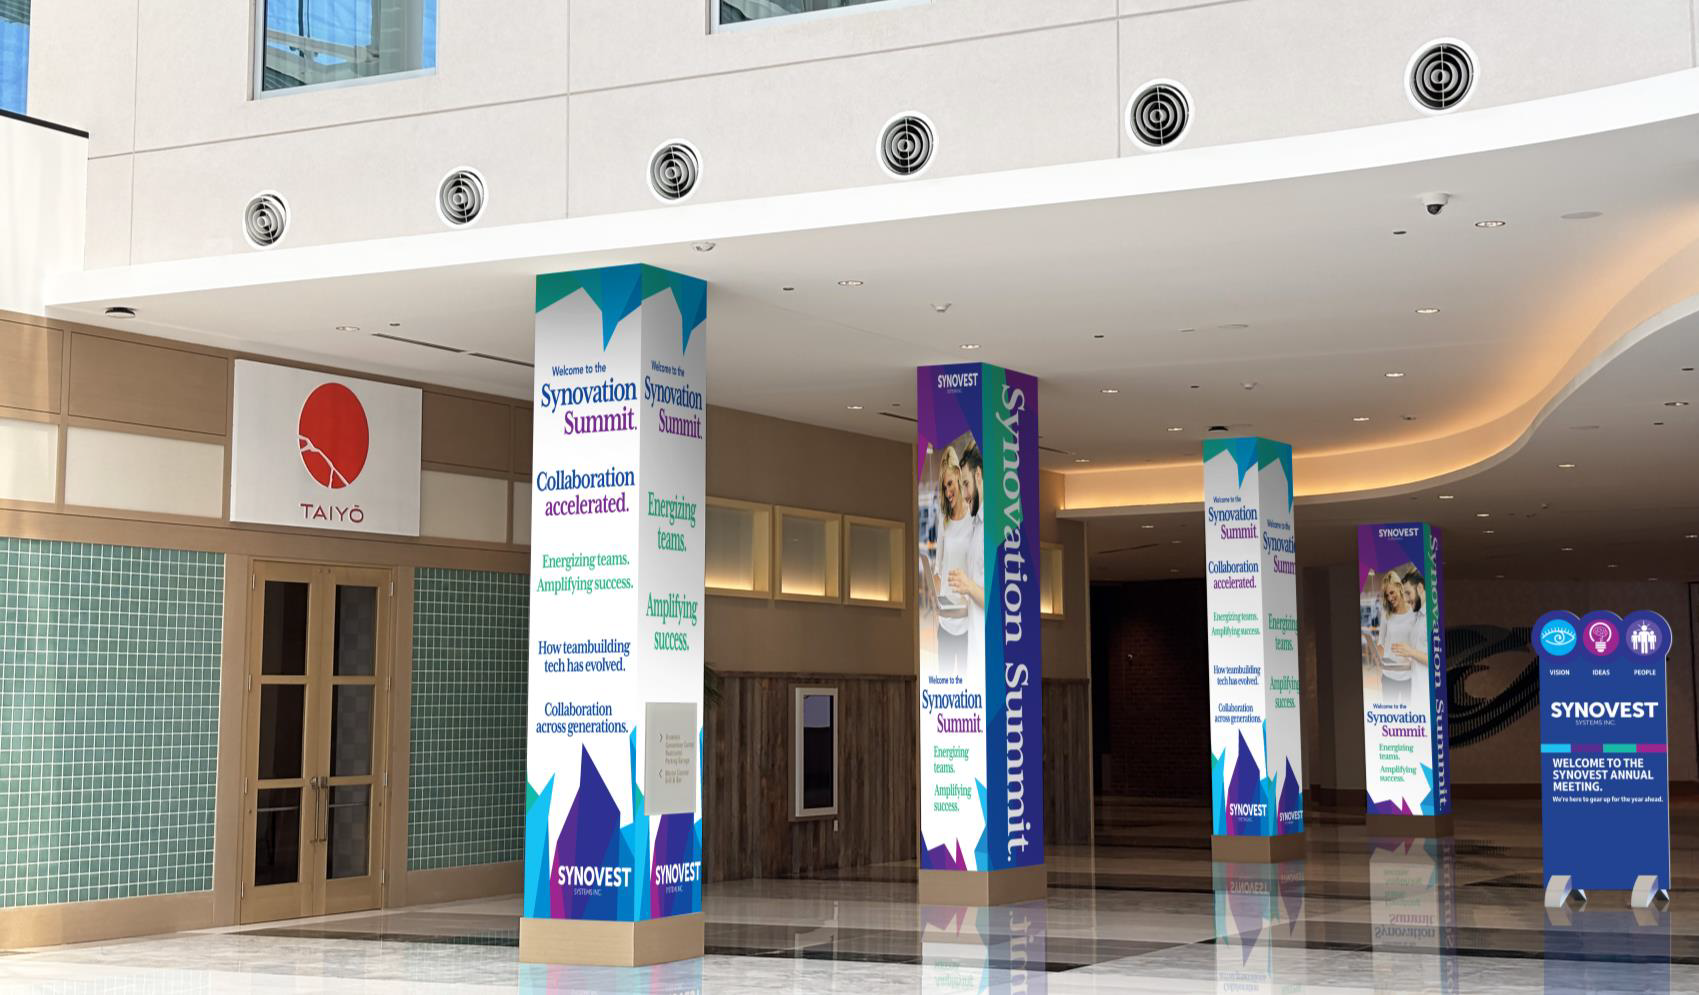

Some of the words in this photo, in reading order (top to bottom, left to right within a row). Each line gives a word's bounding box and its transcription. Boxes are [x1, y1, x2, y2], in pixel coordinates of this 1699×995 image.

[552, 365, 583, 377] Welcome
[585, 365, 593, 374] to
[594, 362, 606, 373] the
[651, 360, 671, 374] Welcome
[672, 365, 676, 375] to
[938, 373, 978, 388] SYNOVEST
[541, 377, 637, 413] Synovation
[644, 376, 702, 410] Synovation
[564, 406, 638, 435] Summit.
[658, 408, 703, 440] Summit.
[536, 466, 635, 492] Collaboration
[545, 492, 629, 516] accelerated.
[648, 491, 697, 528] Energizing
[996, 384, 1028, 646] Synovation
[1208, 506, 1258, 526] Synovation
[657, 527, 687, 552] teams.
[1221, 523, 1258, 540] Summit.
[1378, 528, 1419, 538] SYNOVEST
[542, 553, 596, 571] Energizing
[597, 553, 630, 566] teams.
[1208, 560, 1259, 574] Collaboration
[536, 576, 593, 595] Amplifying
[594, 577, 634, 590] success.
[1214, 576, 1256, 589] accelerated.
[646, 592, 698, 626] Amplifying
[1214, 612, 1241, 624] Energizing
[1212, 626, 1240, 638] Amplifying
[538, 640, 562, 655] How
[563, 639, 630, 657] teambuilding
[654, 630, 690, 651] success.
[544, 659, 564, 673] tech
[567, 658, 584, 672] has
[586, 657, 626, 672] evolved.
[1214, 665, 1225, 674] How
[1226, 665, 1261, 676] teambuilding
[1429, 534, 1442, 688] Synovation
[1436, 698, 1448, 812] Summit.
[928, 675, 948, 685] Welcome
[950, 676, 954, 684] to
[1217, 676, 1228, 685] tech
[1229, 676, 1237, 685] has
[544, 701, 612, 717] Collaboration
[922, 689, 982, 714] Synovation
[1218, 703, 1254, 712] Collaboration
[1551, 702, 1659, 718] SYNOVEST
[937, 713, 983, 734] Summit.
[1214, 715, 1230, 723] across
[1367, 711, 1426, 726] Synovation
[536, 722, 566, 733] across
[567, 718, 629, 737] generations.
[1382, 725, 1427, 737] Summit.
[934, 745, 970, 761] Energizing
[1379, 744, 1414, 753] Energizing
[934, 760, 956, 774] teams.
[1005, 662, 1031, 862] Summit.
[1380, 765, 1417, 775] Amplifying
[1552, 758, 1605, 768] WELCOME
[1607, 758, 1621, 768] TO
[1623, 758, 1644, 768] THE
[1552, 770, 1608, 780] SYNOVEST
[1610, 770, 1654, 780] ANNUAL
[934, 783, 972, 802] Amplifying
[1553, 782, 1603, 792] MEETING.
[934, 800, 960, 812] success.
[1230, 803, 1267, 816] SYNOVEST
[1280, 810, 1304, 822] SYNOVEST
[558, 865, 632, 887] SYNOVEST
[656, 862, 701, 886] SYNOVEST
